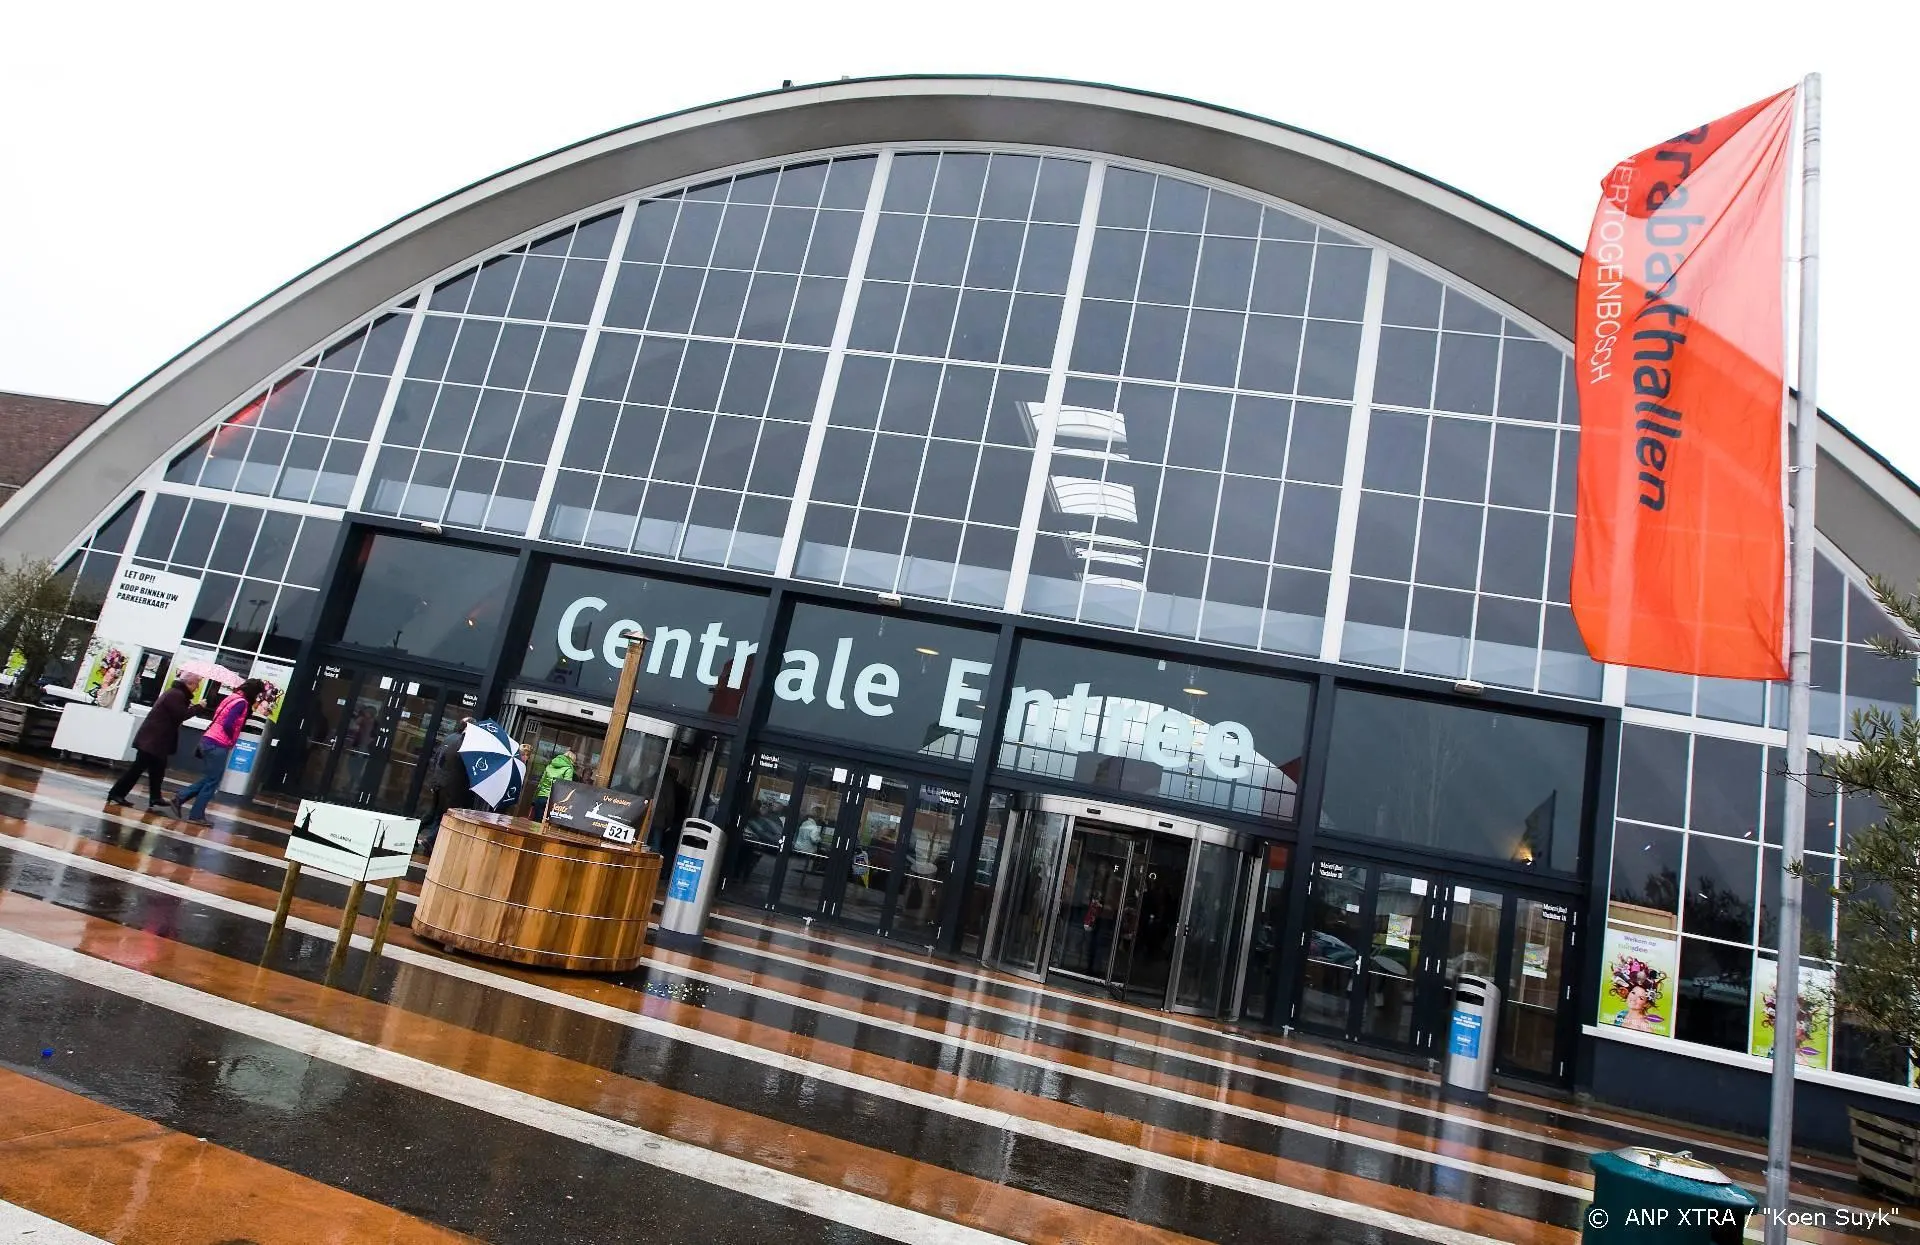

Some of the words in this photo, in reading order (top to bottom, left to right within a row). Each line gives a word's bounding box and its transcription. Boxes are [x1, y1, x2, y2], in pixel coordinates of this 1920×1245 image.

[124, 569, 138, 579] LET
[138, 572, 156, 583] OP!!
[119, 583, 140, 592] KOOP
[139, 587, 165, 599] BINNEN
[165, 593, 179, 601] UW
[116, 592, 169, 609] PARKEERKAART
[557, 596, 900, 717] Centrale
[939, 658, 1255, 778] Entree
[608, 826, 629, 840] 521
[1624, 936, 1647, 944] Welkom
